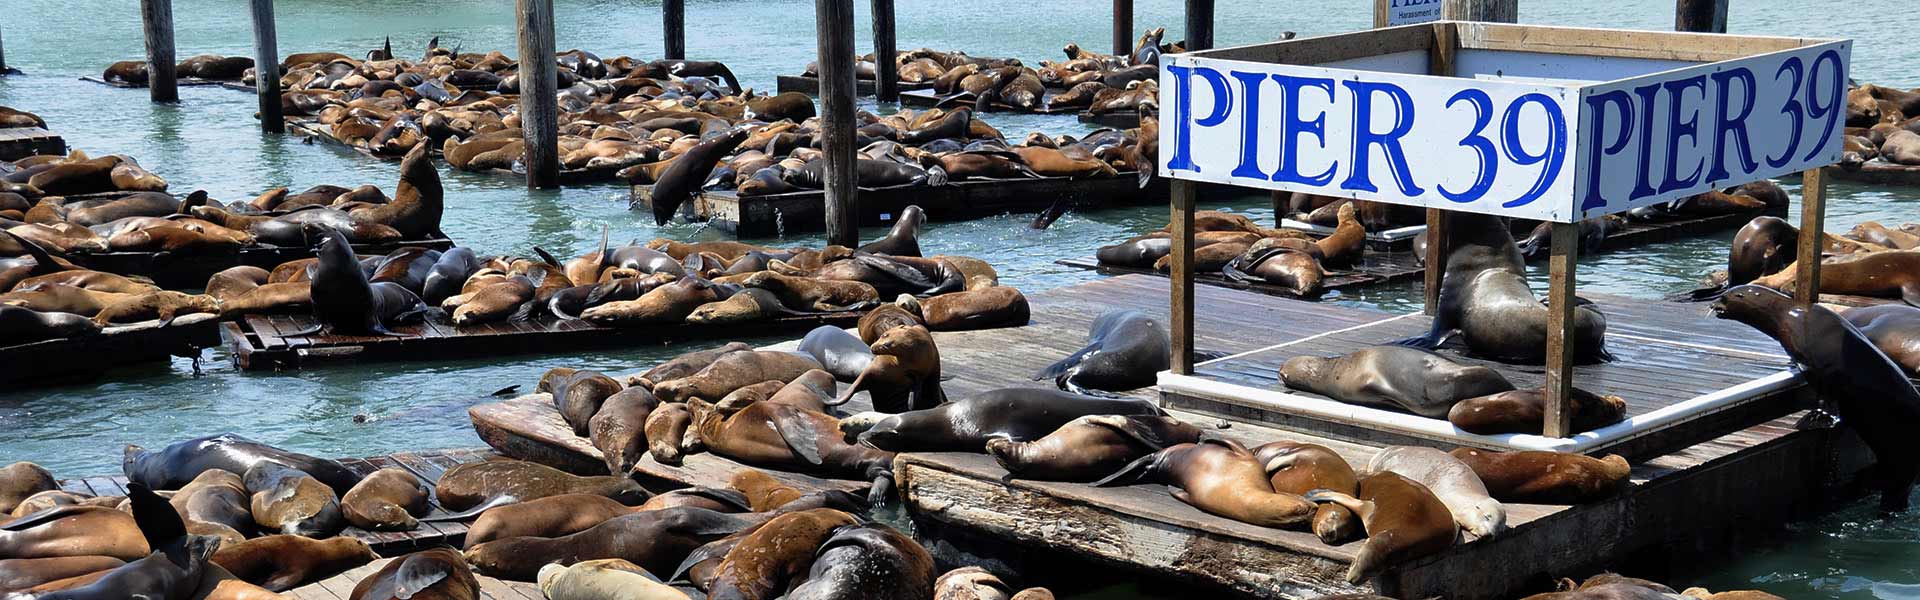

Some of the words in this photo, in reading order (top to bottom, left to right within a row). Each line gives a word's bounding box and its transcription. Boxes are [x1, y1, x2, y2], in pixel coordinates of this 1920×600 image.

[1398, 9, 1432, 19] Harassment
[1166, 65, 1425, 197] PIER
[1437, 89, 1568, 209] 39
[1581, 67, 1759, 211] PIER
[1765, 49, 1844, 169] 39
